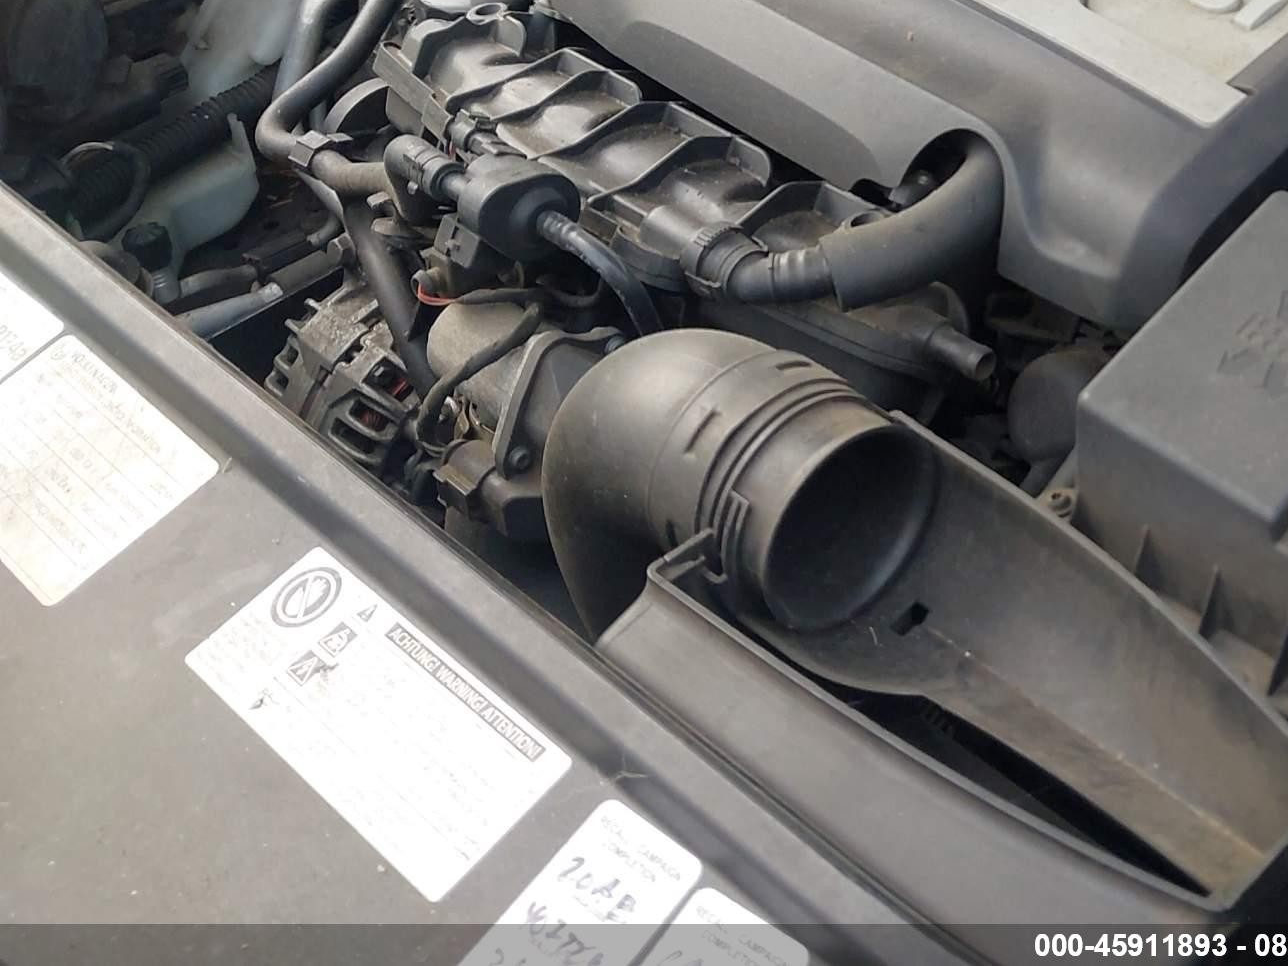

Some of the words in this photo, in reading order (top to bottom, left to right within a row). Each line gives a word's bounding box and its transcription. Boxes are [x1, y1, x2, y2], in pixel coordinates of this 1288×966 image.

[388, 626, 441, 673] ACHTUNG!
[434, 662, 489, 714] WARNING!
[480, 705, 542, 760] ATTENTION!
